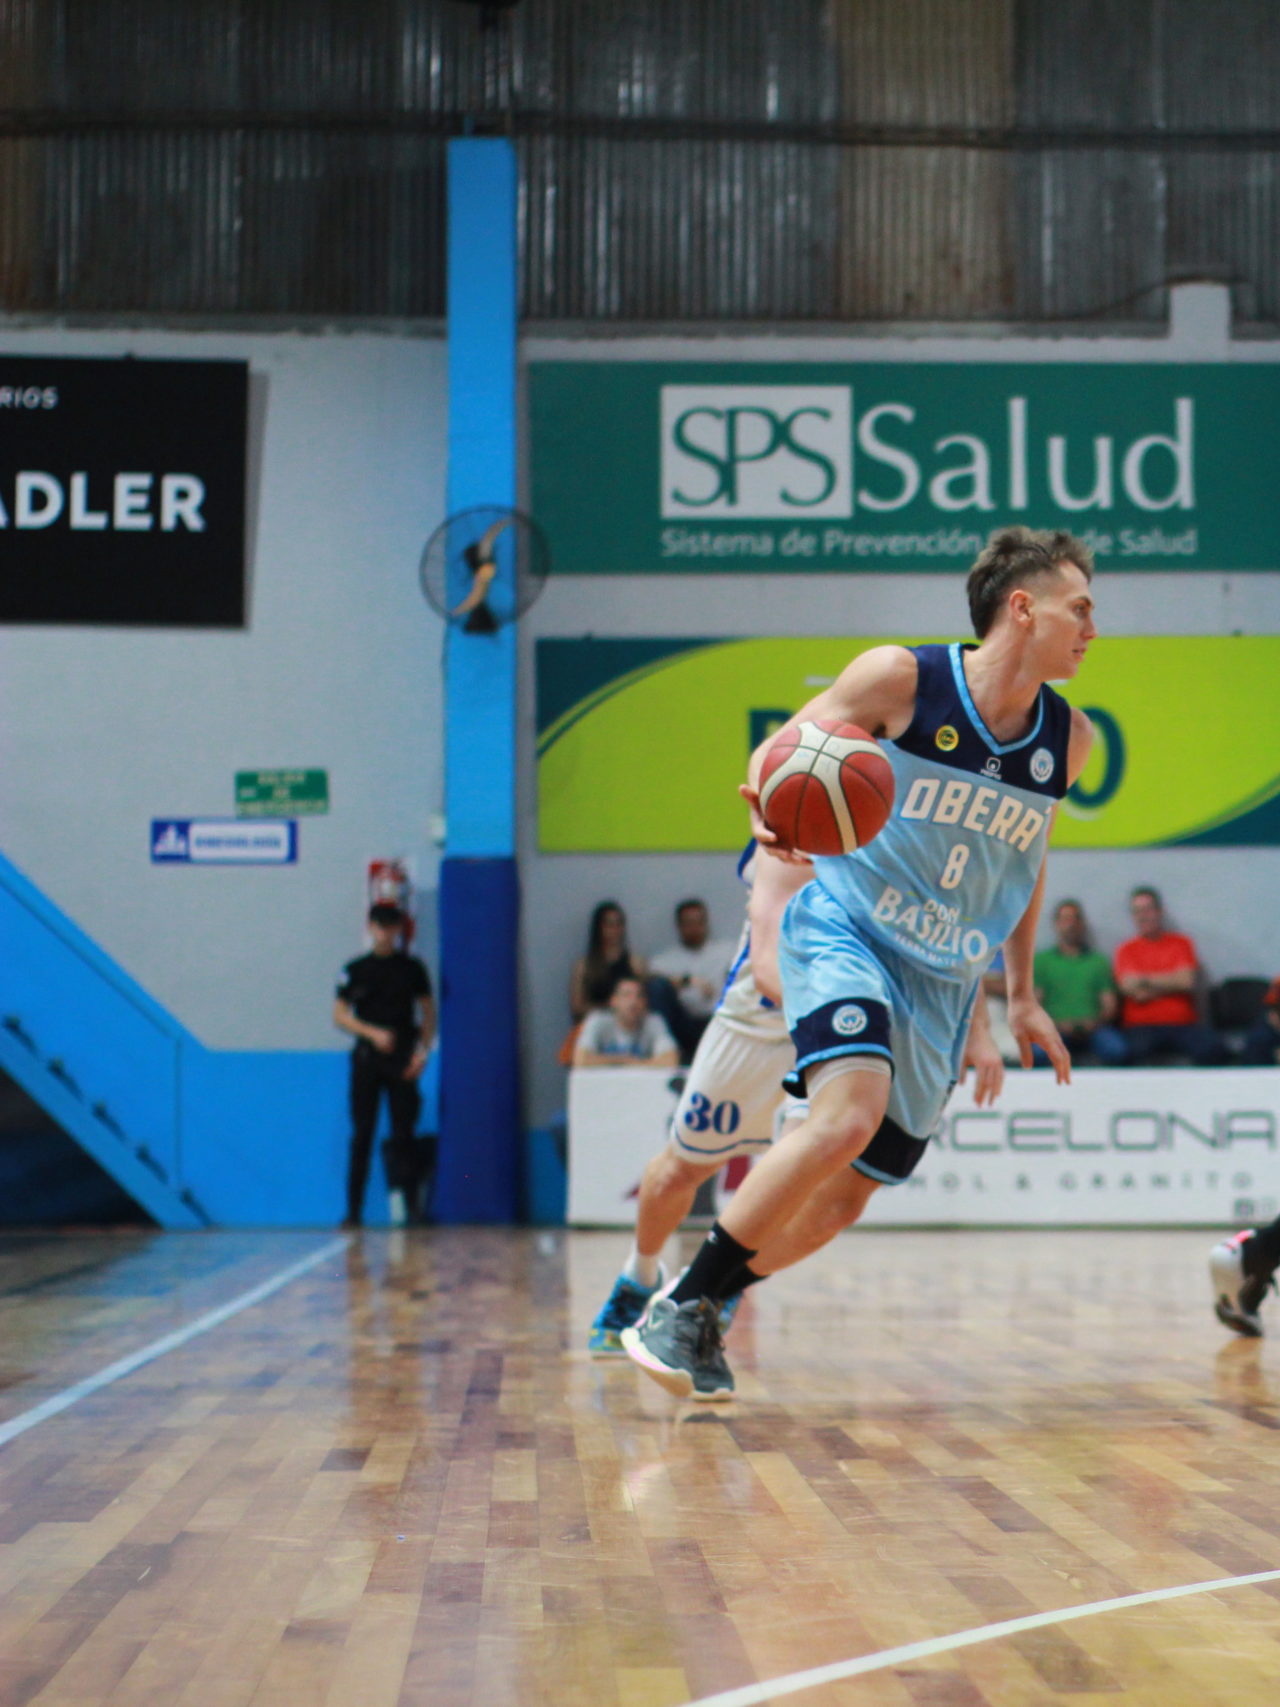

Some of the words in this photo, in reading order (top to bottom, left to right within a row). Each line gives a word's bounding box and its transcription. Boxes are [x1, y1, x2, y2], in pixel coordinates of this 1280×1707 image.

[671, 405, 838, 507] SPS
[857, 397, 1196, 513] Salud
[0, 469, 207, 533] DLER
[661, 530, 775, 556] Sistema
[780, 529, 817, 556] de
[824, 528, 983, 556] Prevención
[1118, 529, 1199, 556] Salud
[940, 844, 970, 890] 8
[872, 885, 989, 963] BASILIO
[684, 1092, 740, 1135] 30
[930, 1110, 1277, 1152] RCELONA
